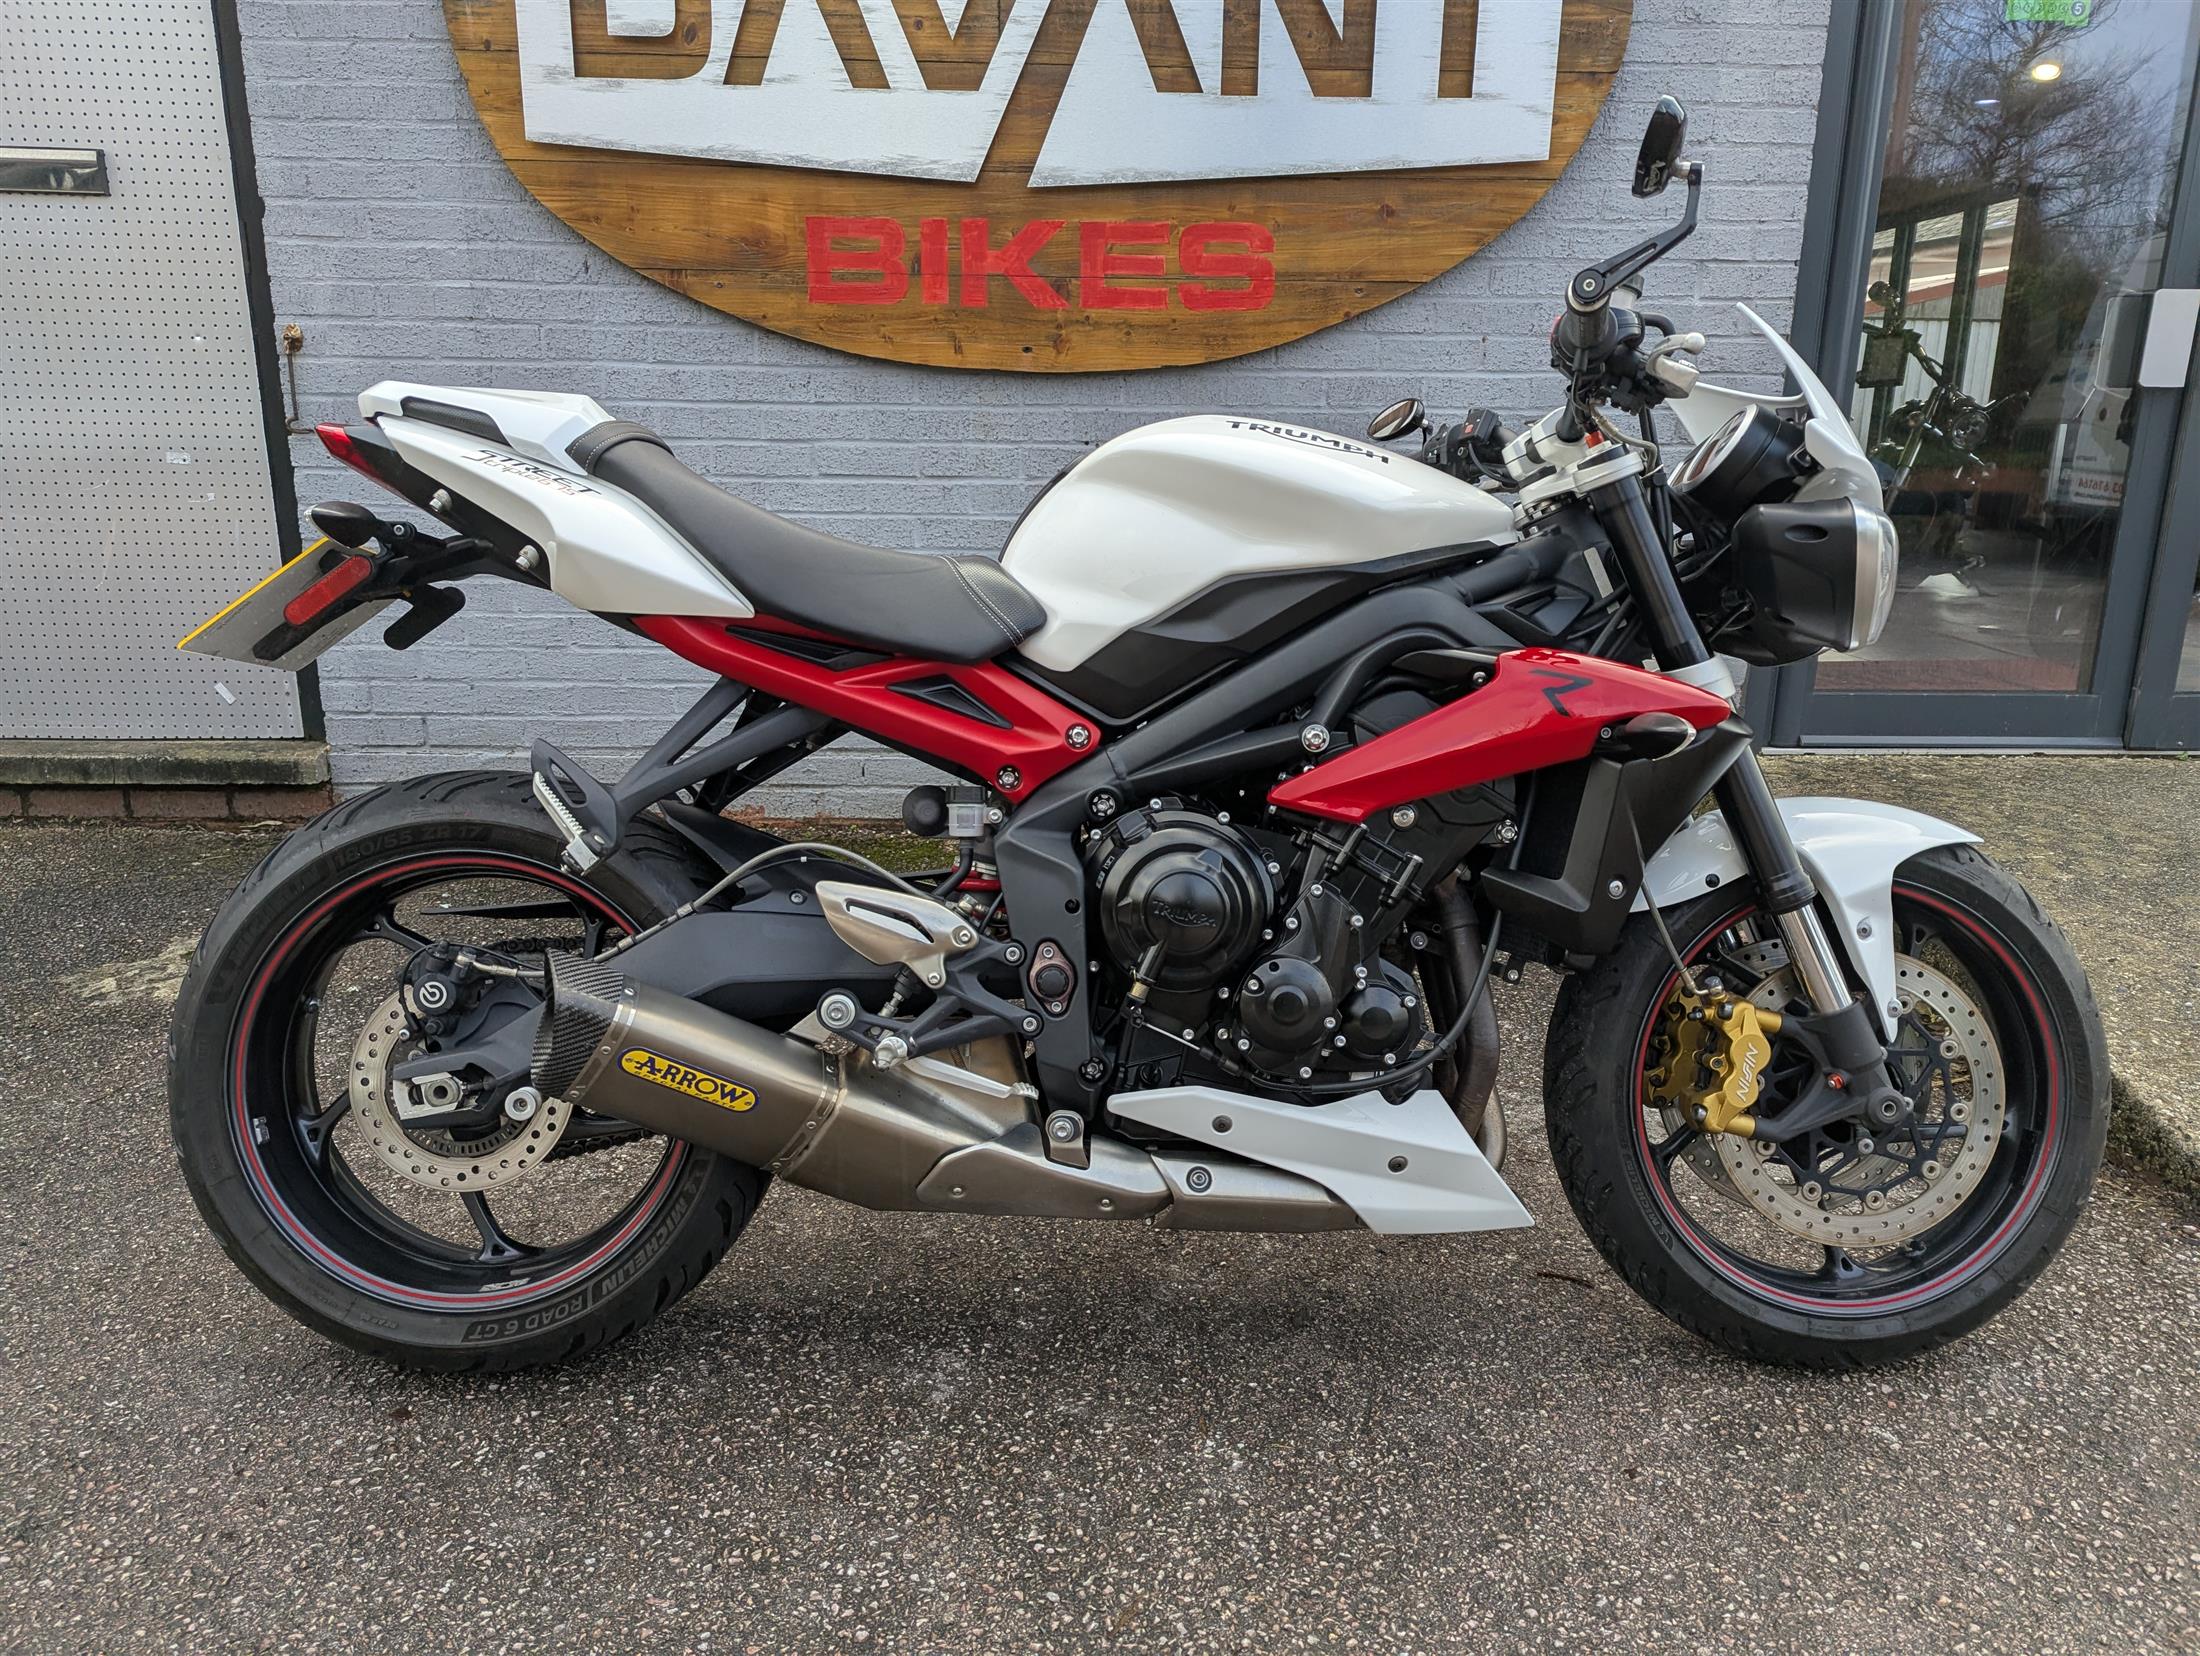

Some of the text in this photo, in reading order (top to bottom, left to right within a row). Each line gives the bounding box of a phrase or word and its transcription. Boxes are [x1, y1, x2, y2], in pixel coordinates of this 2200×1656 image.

[805, 215, 1275, 311] BIKES
[1226, 419, 1389, 464] TRIUMPH
[461, 449, 602, 495] STREET
[634, 1055, 749, 1104] ARROW
[634, 1070, 736, 1109] SPECIAL PARTS
[1736, 1041, 1759, 1103] NISSIN
[468, 1196, 690, 1339] MICHELIN ROAD 6 GT
